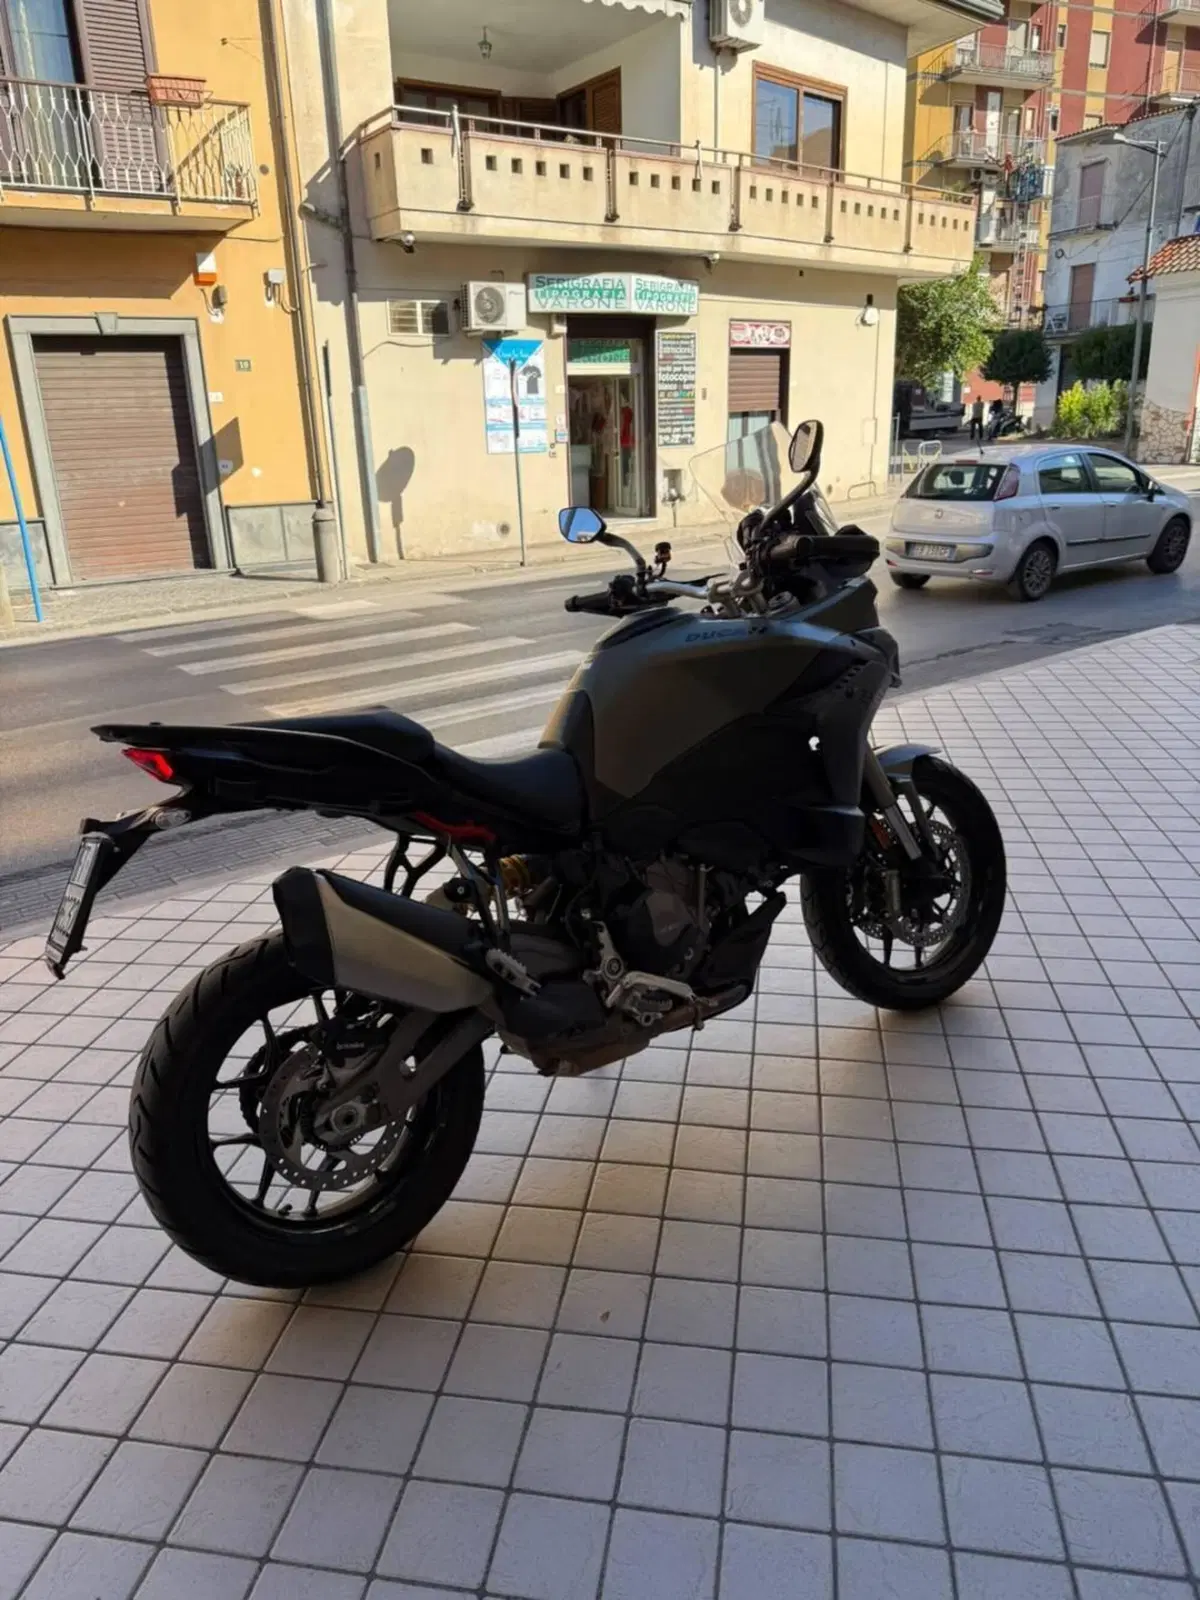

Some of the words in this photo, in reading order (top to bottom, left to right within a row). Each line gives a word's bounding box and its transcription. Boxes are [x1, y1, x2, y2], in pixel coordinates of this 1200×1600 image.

[536, 275, 625, 290] SERIGRAFIA
[536, 289, 625, 299] TIPOGRAFIA
[537, 298, 627, 310] VARONE
[635, 299, 695, 313] VARONE
